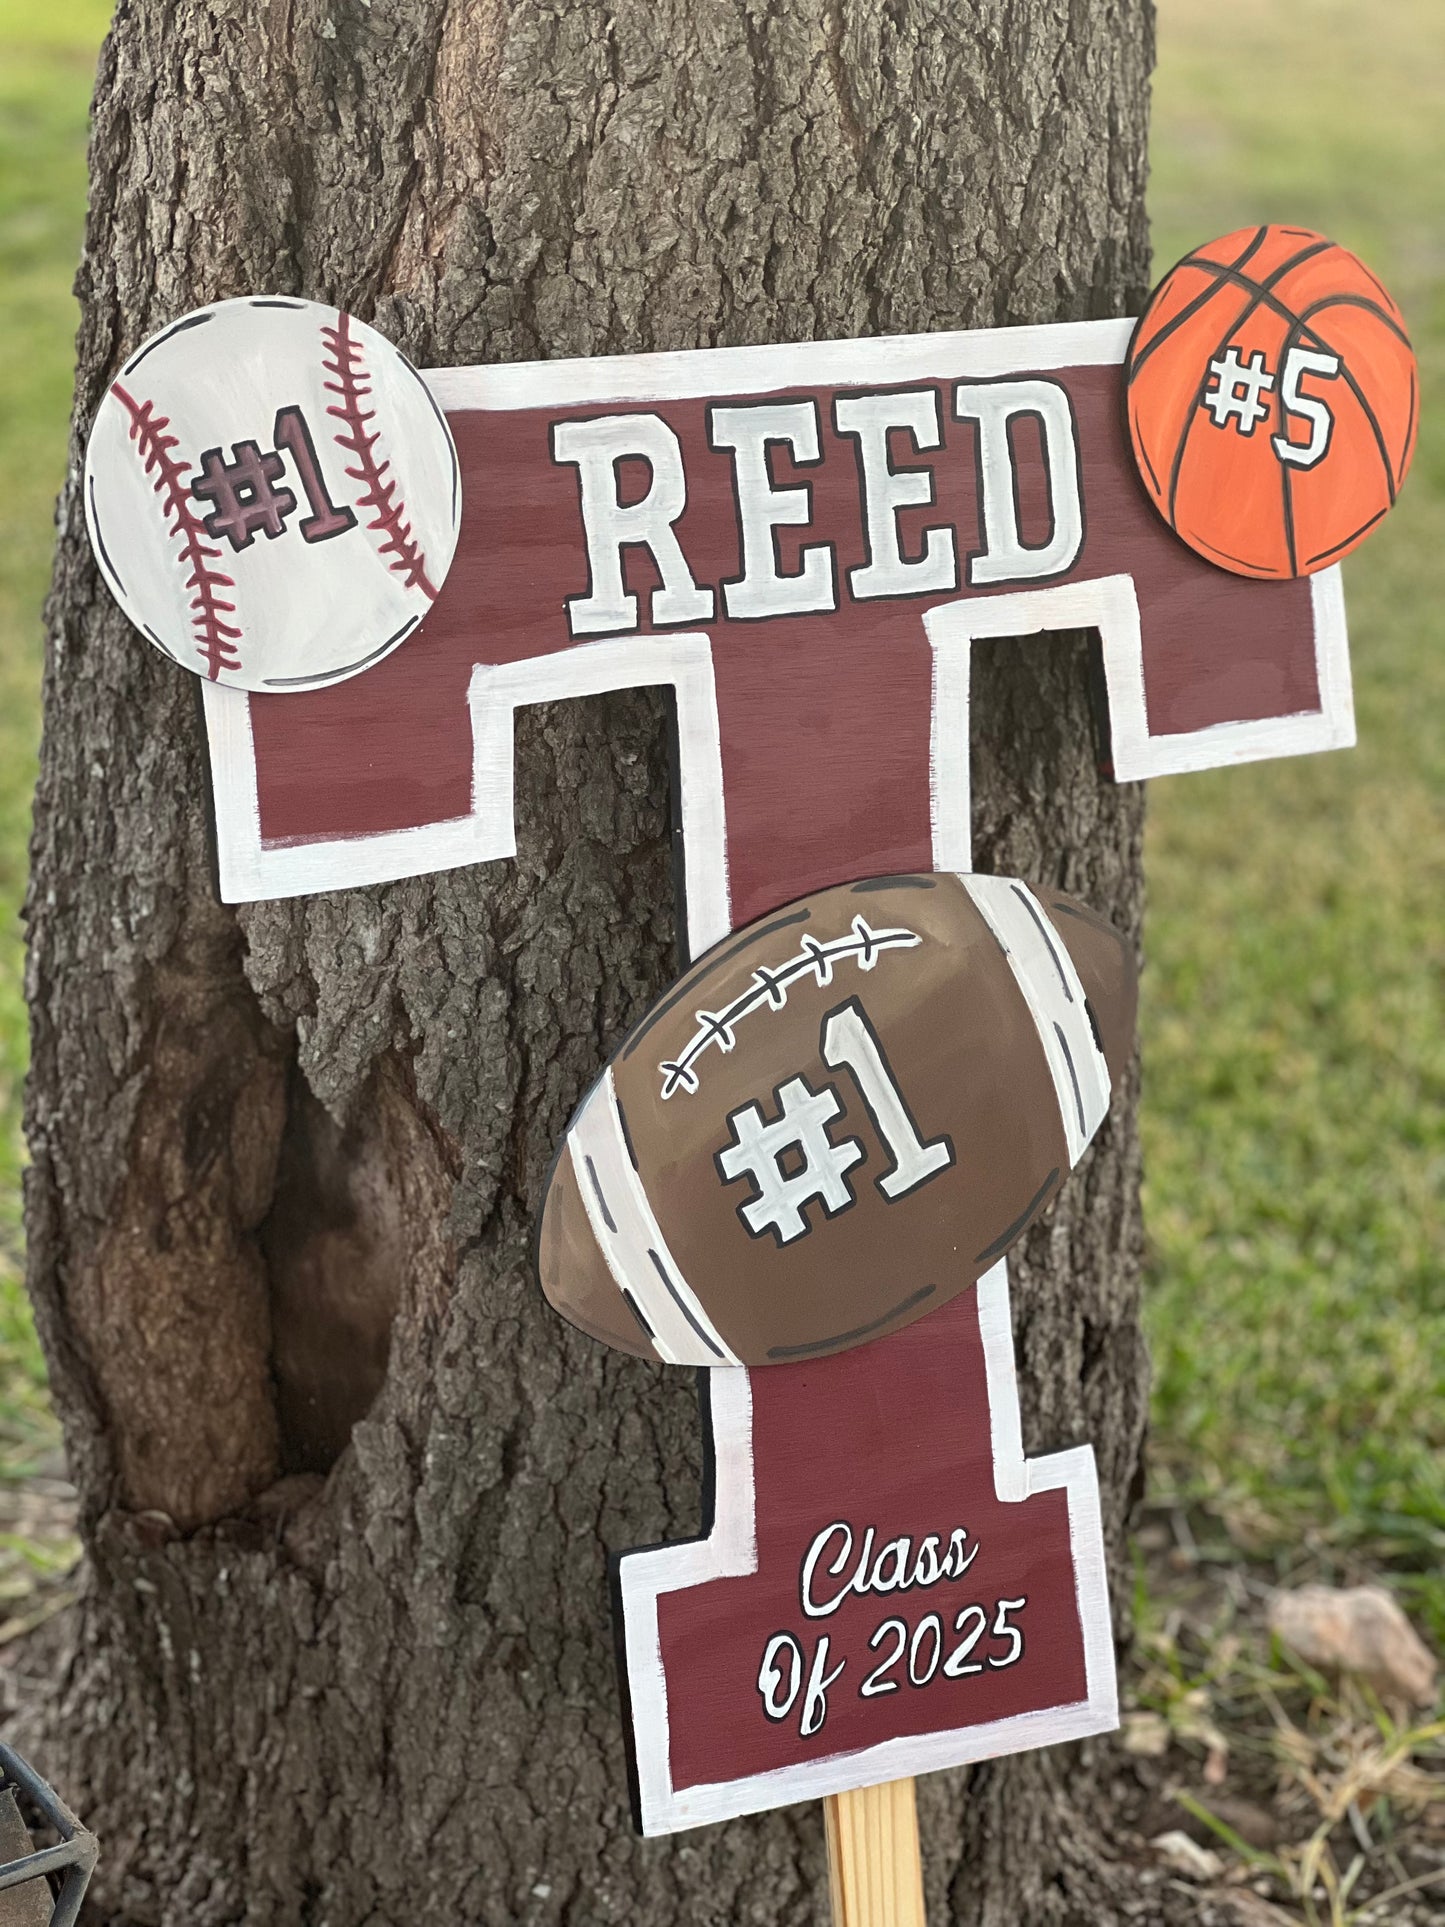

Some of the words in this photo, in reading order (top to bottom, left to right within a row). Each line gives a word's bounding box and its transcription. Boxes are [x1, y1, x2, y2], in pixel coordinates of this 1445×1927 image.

[190, 404, 358, 552] #1
[1203, 343, 1342, 470] #5
[549, 377, 1084, 638] REED
[714, 994, 957, 1247] #1
[801, 1520, 980, 1618] Class
[757, 1630, 847, 1738] Of
[859, 1596, 1027, 1699] 2025
